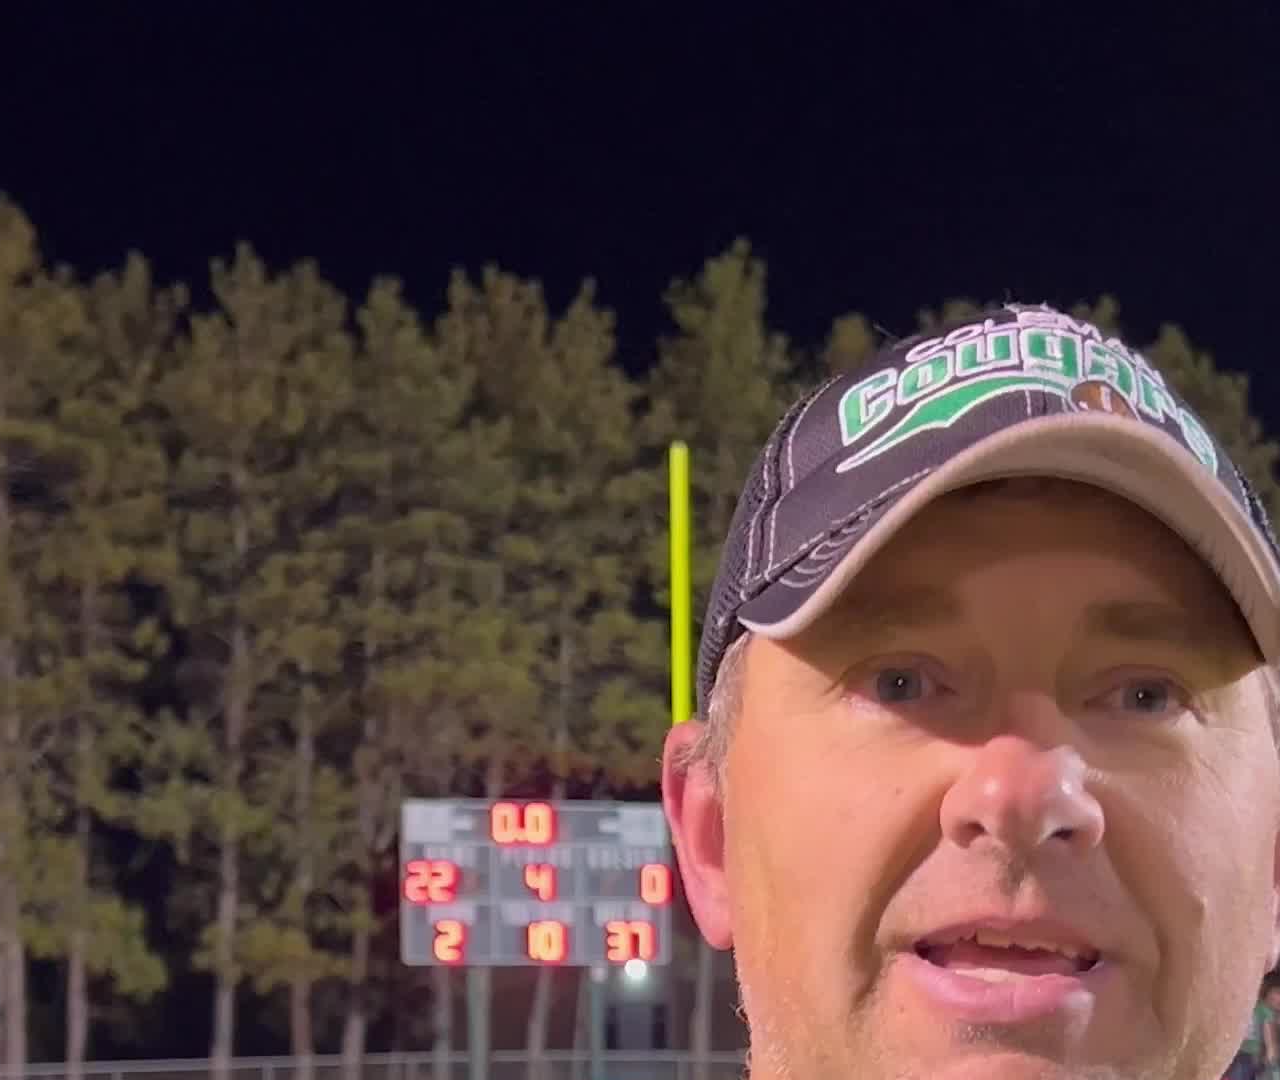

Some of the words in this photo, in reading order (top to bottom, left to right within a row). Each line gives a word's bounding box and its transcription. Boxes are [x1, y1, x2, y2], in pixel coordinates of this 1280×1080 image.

[405, 860, 458, 902] 22
[525, 864, 554, 901] 4
[641, 866, 668, 904] 0
[434, 920, 463, 961] 2
[607, 920, 656, 961] 37
